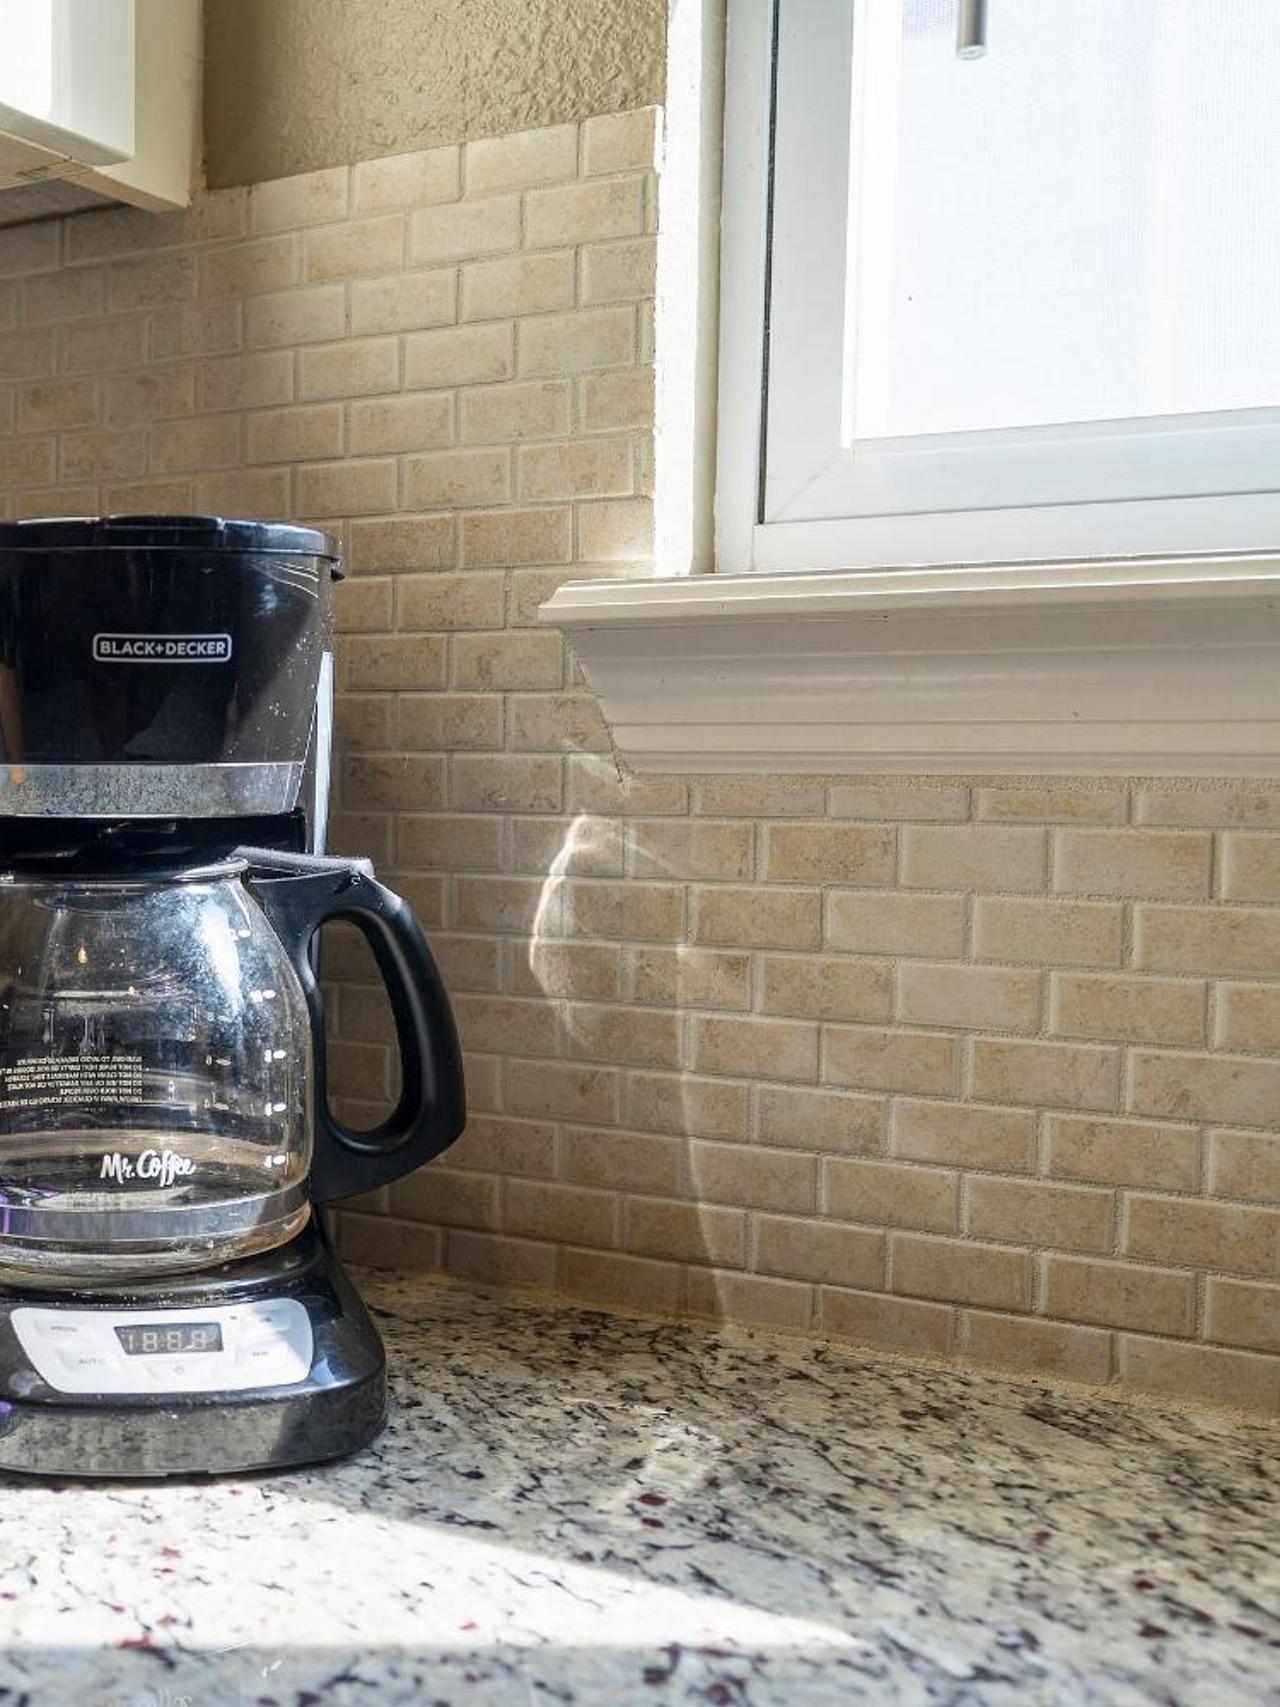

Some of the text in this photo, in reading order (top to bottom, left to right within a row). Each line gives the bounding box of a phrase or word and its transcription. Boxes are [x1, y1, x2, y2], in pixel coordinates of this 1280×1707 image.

[100, 641, 225, 656] BLACK+DECKER
[100, 1149, 197, 1187] Mr. Coffee
